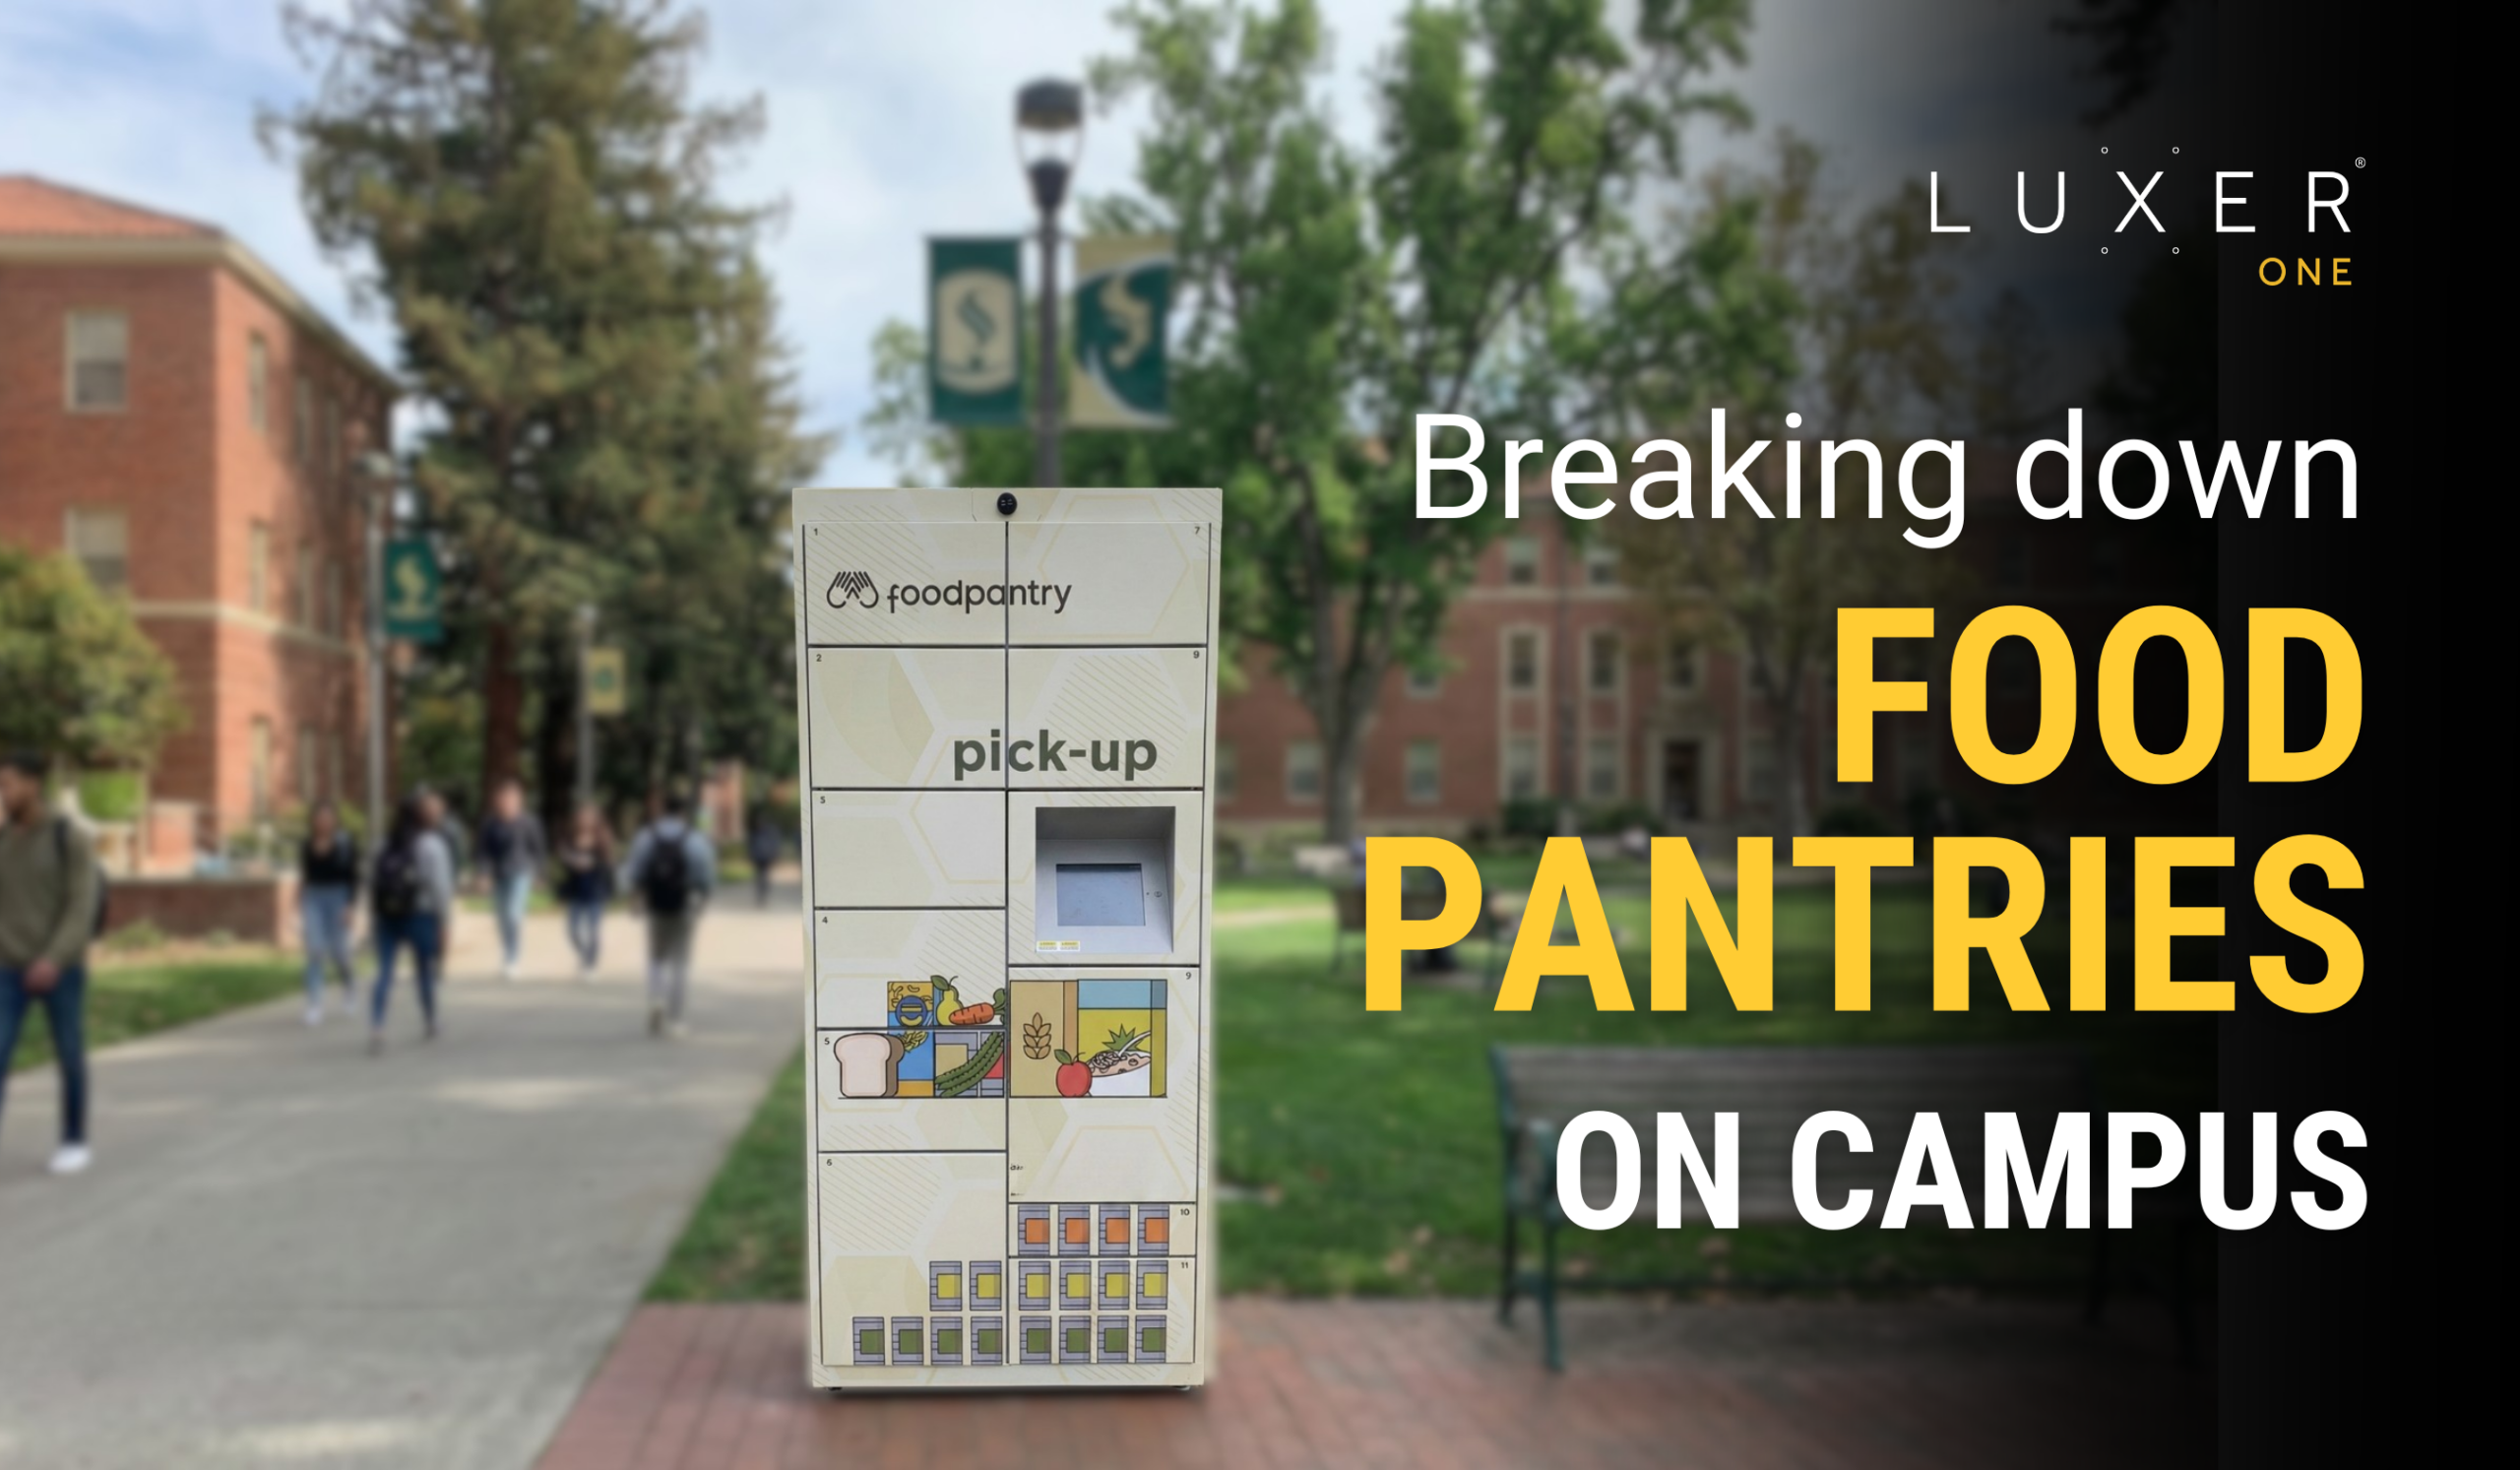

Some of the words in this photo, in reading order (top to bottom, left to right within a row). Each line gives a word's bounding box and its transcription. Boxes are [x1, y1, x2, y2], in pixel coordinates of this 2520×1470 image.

[1194, 526, 1201, 535] 7
[887, 579, 1073, 614] foodpantry
[815, 653, 823, 663] 2
[953, 729, 1159, 782] pick-up
[1185, 972, 1192, 981] 9
[824, 1037, 831, 1046] 5
[1179, 1208, 1190, 1217] 10
